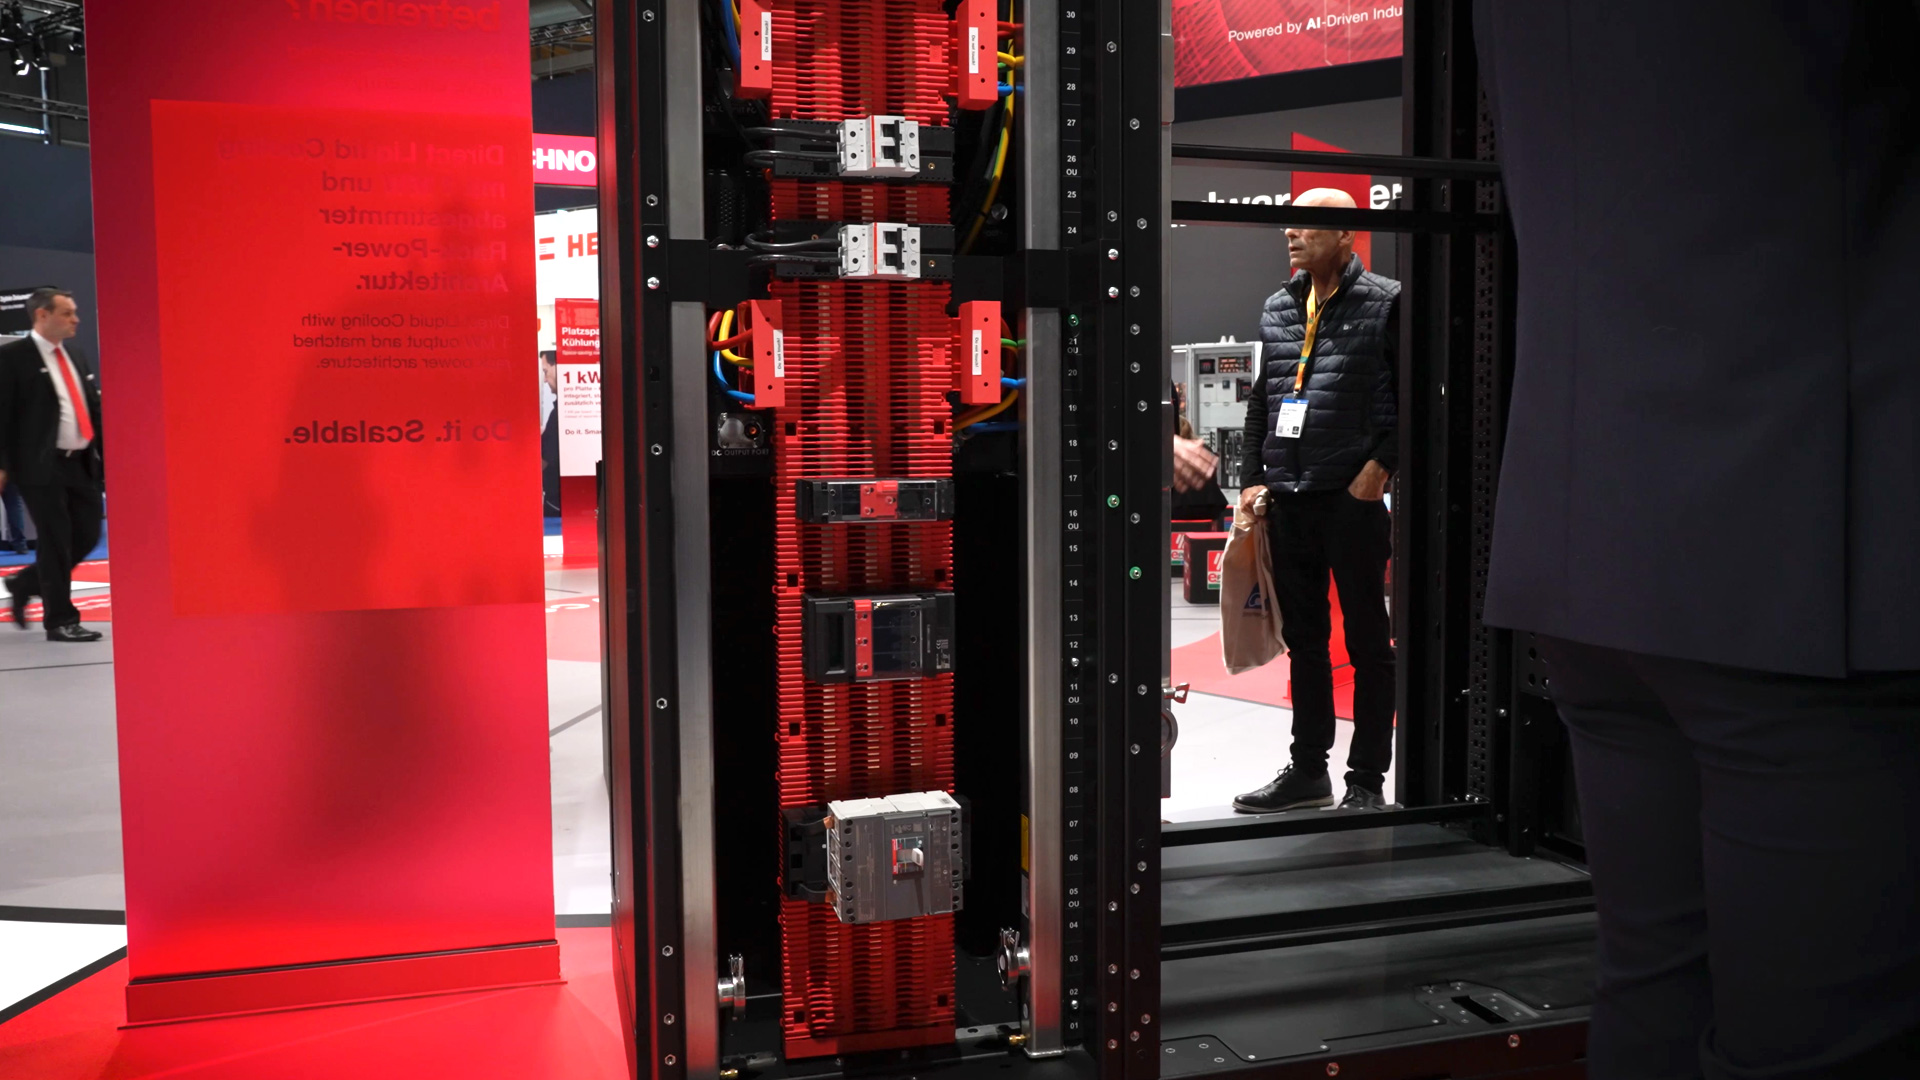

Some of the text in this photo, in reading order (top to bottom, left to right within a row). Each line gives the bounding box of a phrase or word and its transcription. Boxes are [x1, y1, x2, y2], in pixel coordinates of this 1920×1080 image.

[1228, 5, 1402, 42] Powered by AI-Driven Indu
[1067, 83, 1077, 91] 28
[1067, 155, 1077, 163] 26
[1066, 168, 1078, 176] OU
[563, 371, 570, 384] 1
[1068, 404, 1078, 412] 19
[1068, 439, 1078, 447] 18
[1068, 474, 1078, 482] 17
[1068, 509, 1078, 517] 16
[1067, 522, 1079, 531] OU
[1069, 544, 1078, 552] 15
[1069, 579, 1079, 587] 14
[1068, 696, 1080, 704] OU
[1069, 717, 1079, 725] 10
[1069, 751, 1079, 759] 09
[1069, 786, 1079, 794] 08
[1069, 820, 1079, 828] 07
[1069, 887, 1079, 895] 05
[1068, 900, 1080, 908] OU
[1069, 921, 1079, 929] 04
[1069, 988, 1079, 996] 02
[1069, 1022, 1079, 1030] 01
